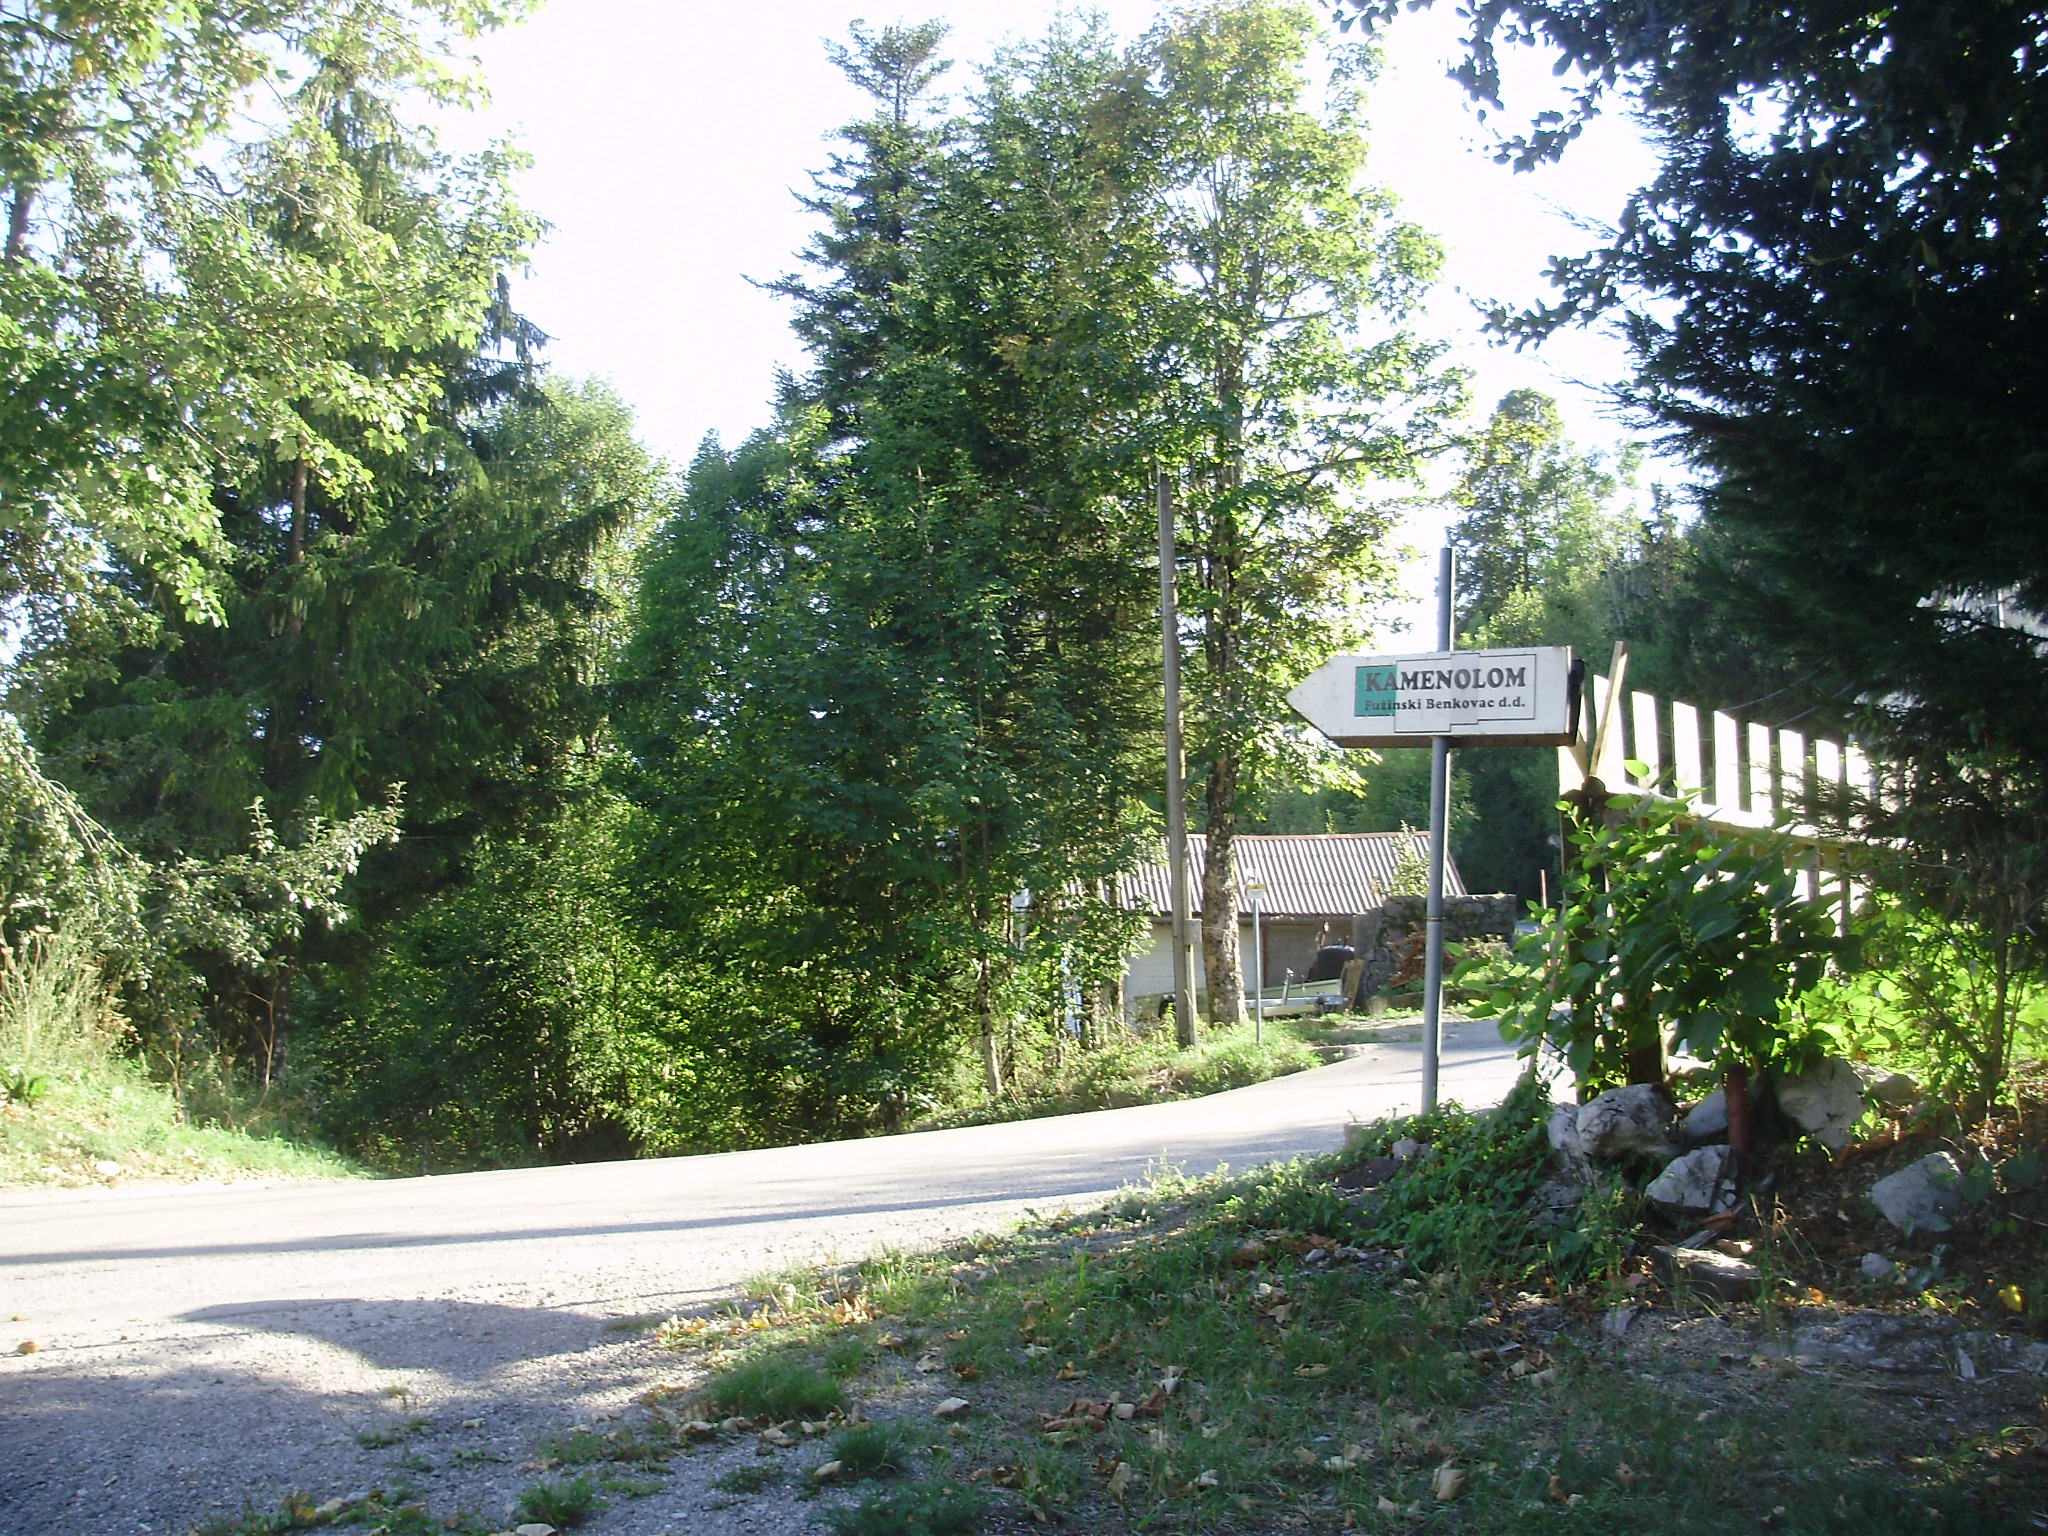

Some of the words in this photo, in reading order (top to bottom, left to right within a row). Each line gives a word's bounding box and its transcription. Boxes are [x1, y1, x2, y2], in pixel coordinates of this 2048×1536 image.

[1365, 667, 1526, 692] KAMENOLOM
[1426, 697, 1495, 709] Benkovac
[1498, 696, 1526, 708] d.d.
